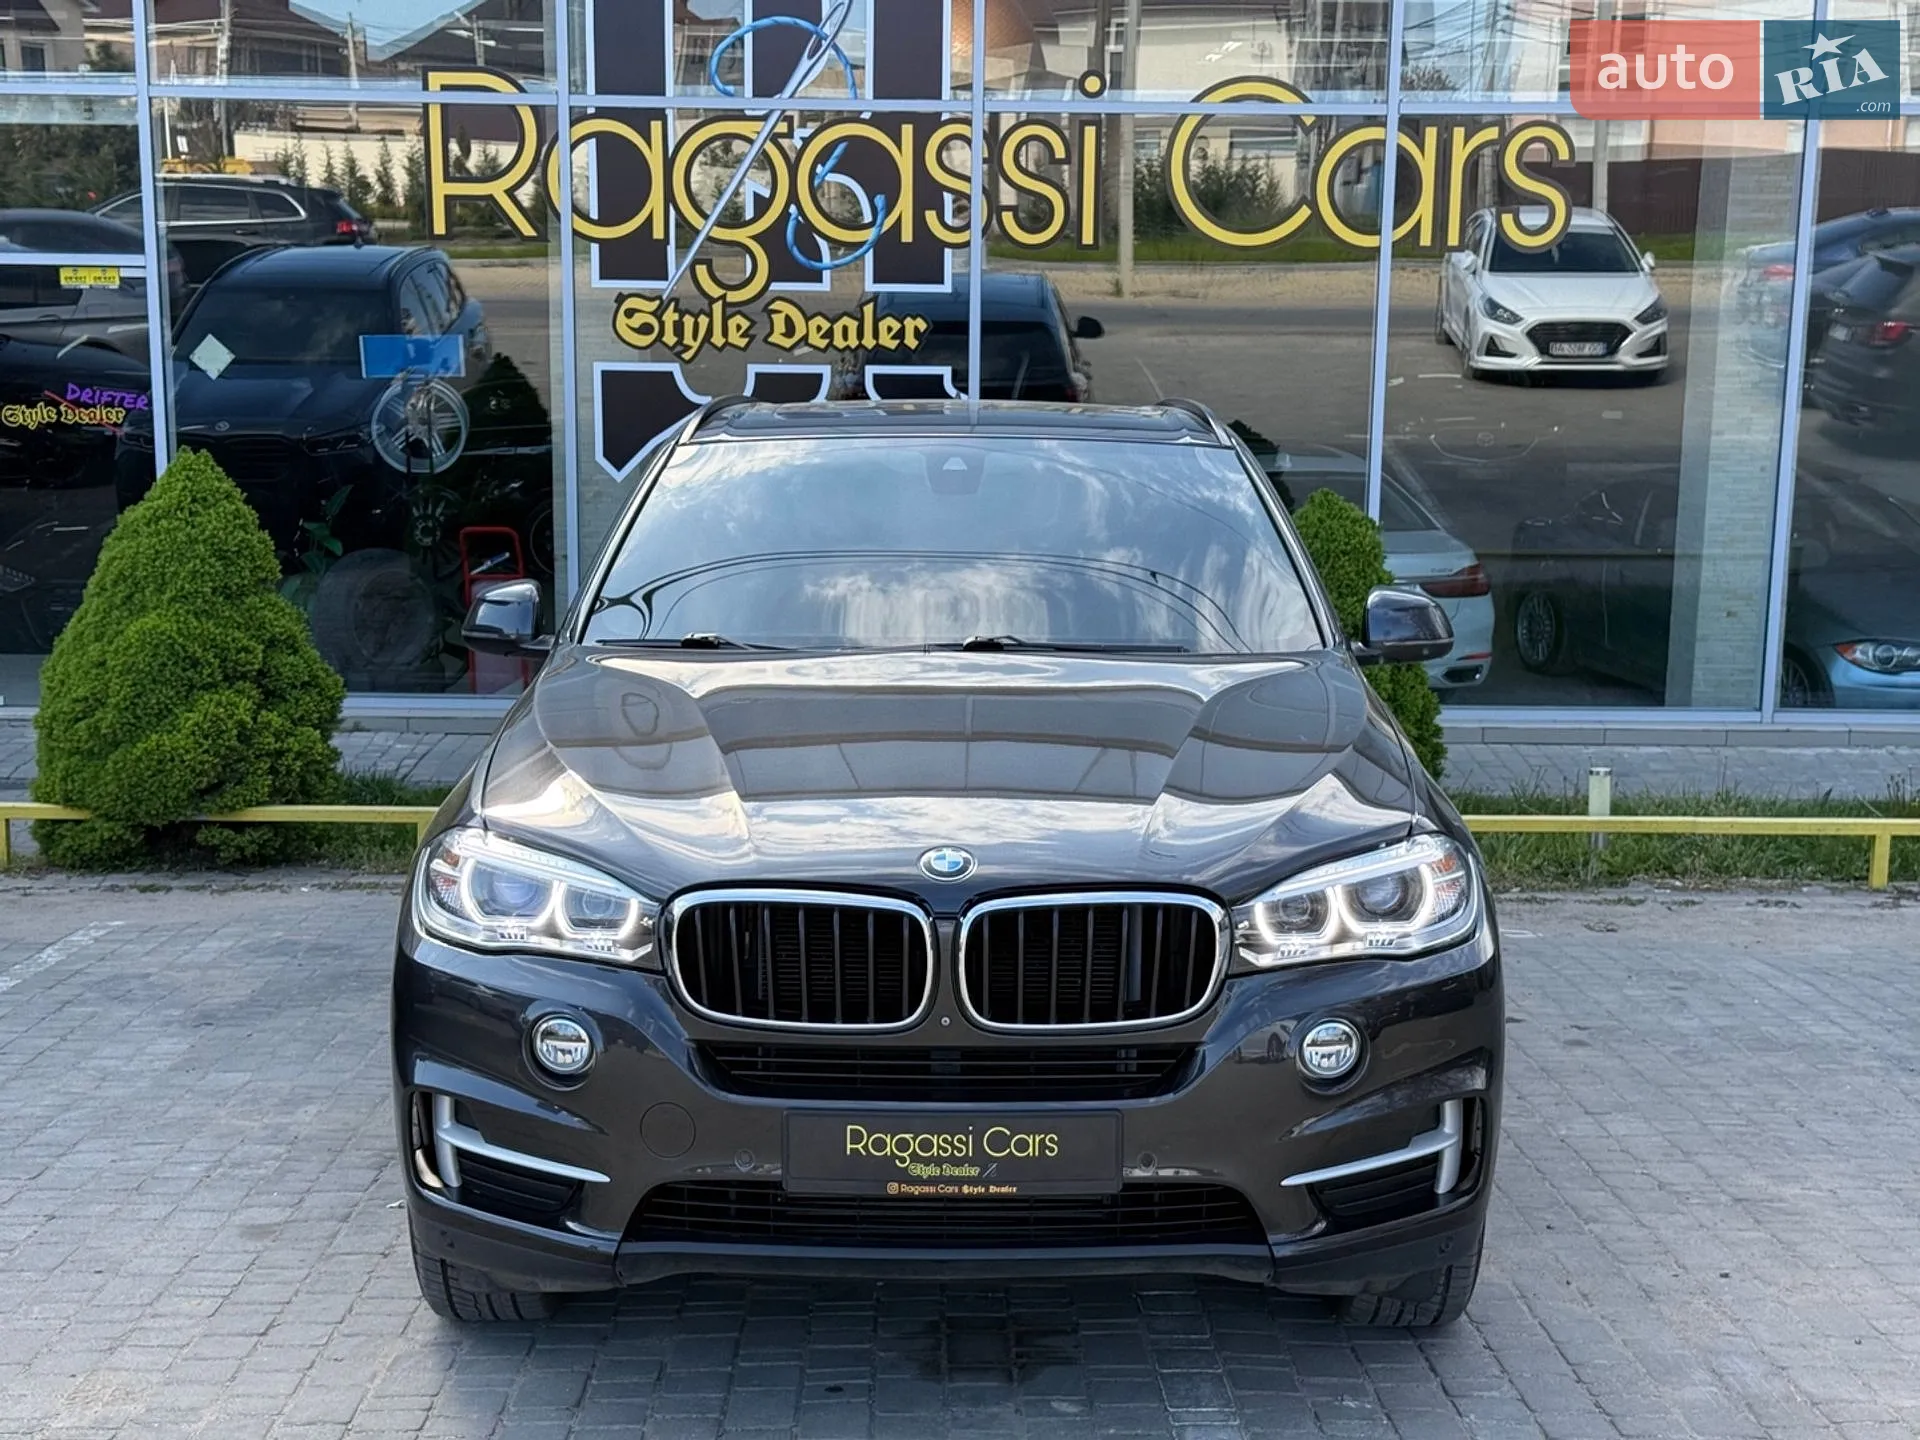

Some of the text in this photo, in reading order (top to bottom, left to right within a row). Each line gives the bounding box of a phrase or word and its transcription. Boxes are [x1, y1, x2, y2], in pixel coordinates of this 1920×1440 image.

[423, 66, 1575, 303] Ragassi Cars
[612, 292, 932, 363] Style Dealer
[65, 382, 149, 410] DRIFTER
[1, 401, 126, 430] Style Dealer
[846, 1125, 1059, 1168] Ragassi Cars
[908, 1163, 981, 1179] Style Dealer
[900, 1183, 937, 1195] Ragassi
[937, 1184, 959, 1194] Cars
[961, 1184, 985, 1194] Style
